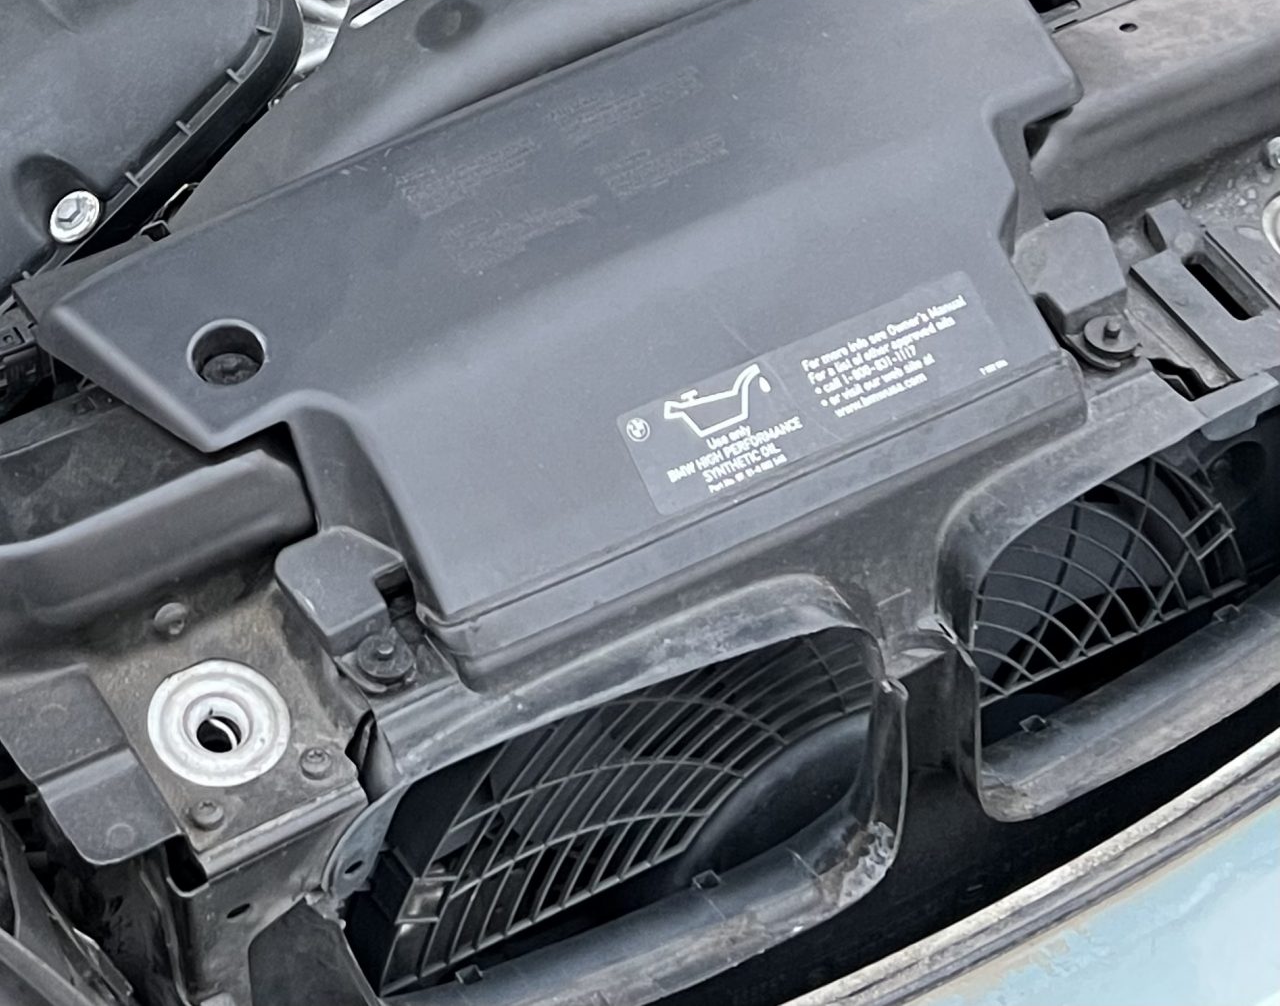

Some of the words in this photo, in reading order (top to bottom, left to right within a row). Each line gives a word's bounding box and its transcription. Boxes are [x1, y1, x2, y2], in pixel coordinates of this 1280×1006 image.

[801, 357, 820, 372] For
[820, 347, 849, 364] more
[886, 312, 930, 336] Owner's
[926, 294, 967, 319] Manual
[807, 370, 826, 385] For
[863, 343, 889, 361] other
[890, 321, 937, 350] approved
[822, 376, 843, 394] call
[834, 372, 928, 418] www.bmwusa.com
[880, 367, 905, 383] web
[666, 461, 696, 483] BMW
[694, 449, 724, 471] HIGH
[721, 416, 804, 459] PERFORMANCE
[706, 434, 729, 450] Use
[728, 425, 751, 442] only
[702, 449, 761, 483] SYNTHETIC
[759, 442, 782, 458] OIL
